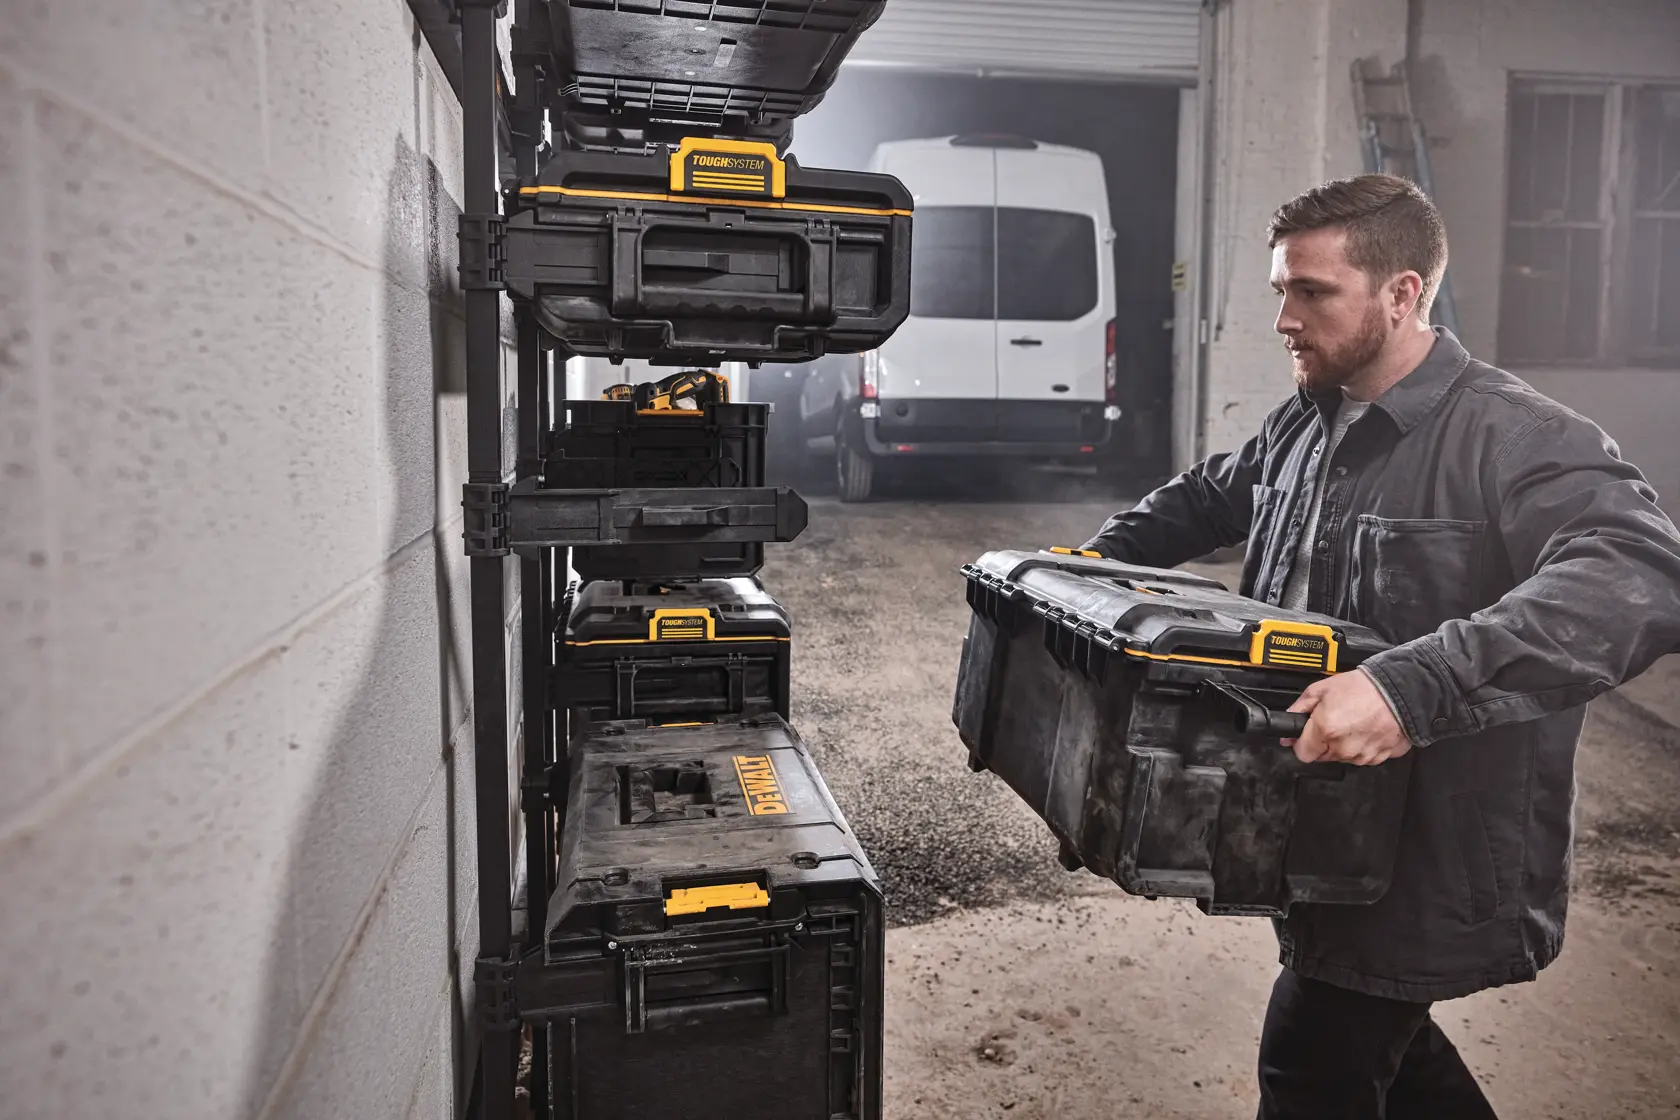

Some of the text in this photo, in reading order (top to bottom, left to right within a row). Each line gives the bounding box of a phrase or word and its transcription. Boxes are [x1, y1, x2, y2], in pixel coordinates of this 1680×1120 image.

[693, 155, 764, 170] TOUGHSYSTEM
[1271, 635, 1324, 650] TOUGHSYSTEM
[737, 755, 788, 815] DEWALT
